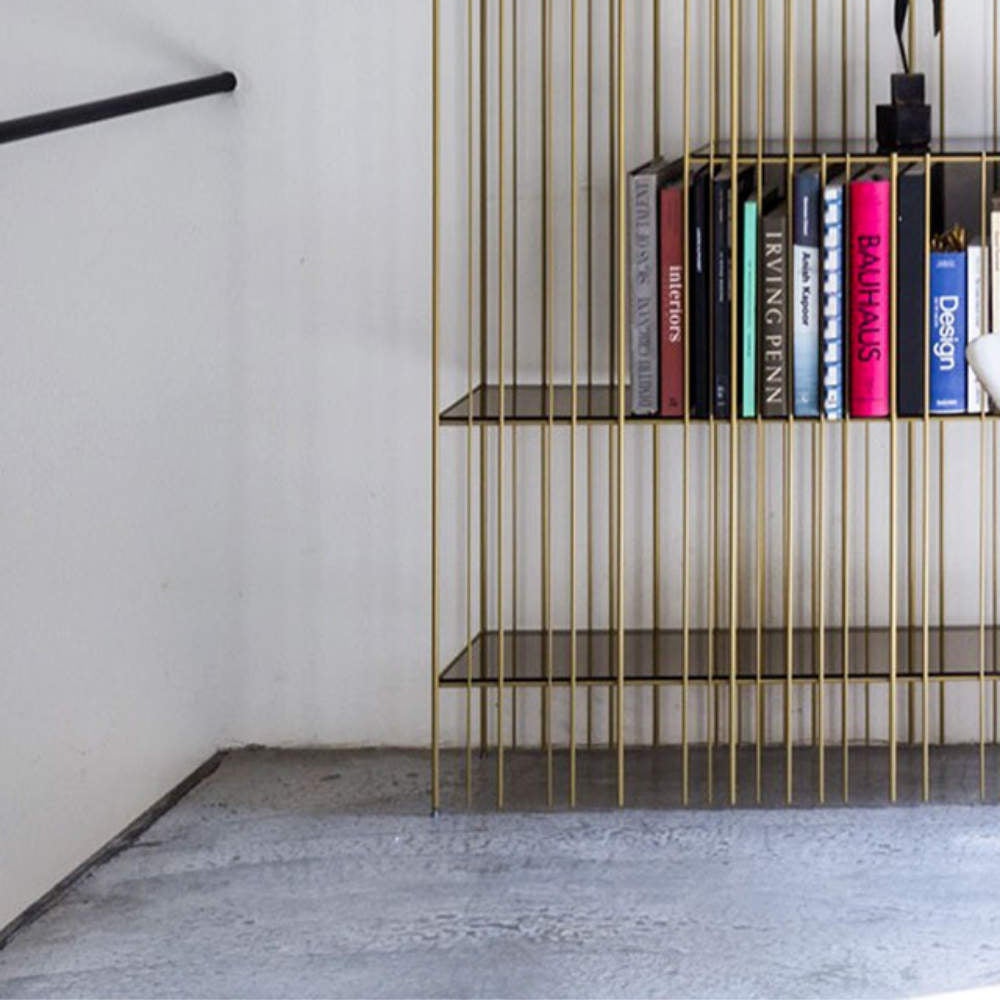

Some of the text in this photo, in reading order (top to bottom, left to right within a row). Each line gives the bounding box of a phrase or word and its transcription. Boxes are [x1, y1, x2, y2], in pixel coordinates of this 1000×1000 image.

[668, 265, 682, 343] interiors
[765, 231, 783, 403] IRVING PENN
[801, 252, 811, 327] Anish Kapoor
[857, 234, 881, 363] BAUHAUS
[933, 295, 959, 371] Design
